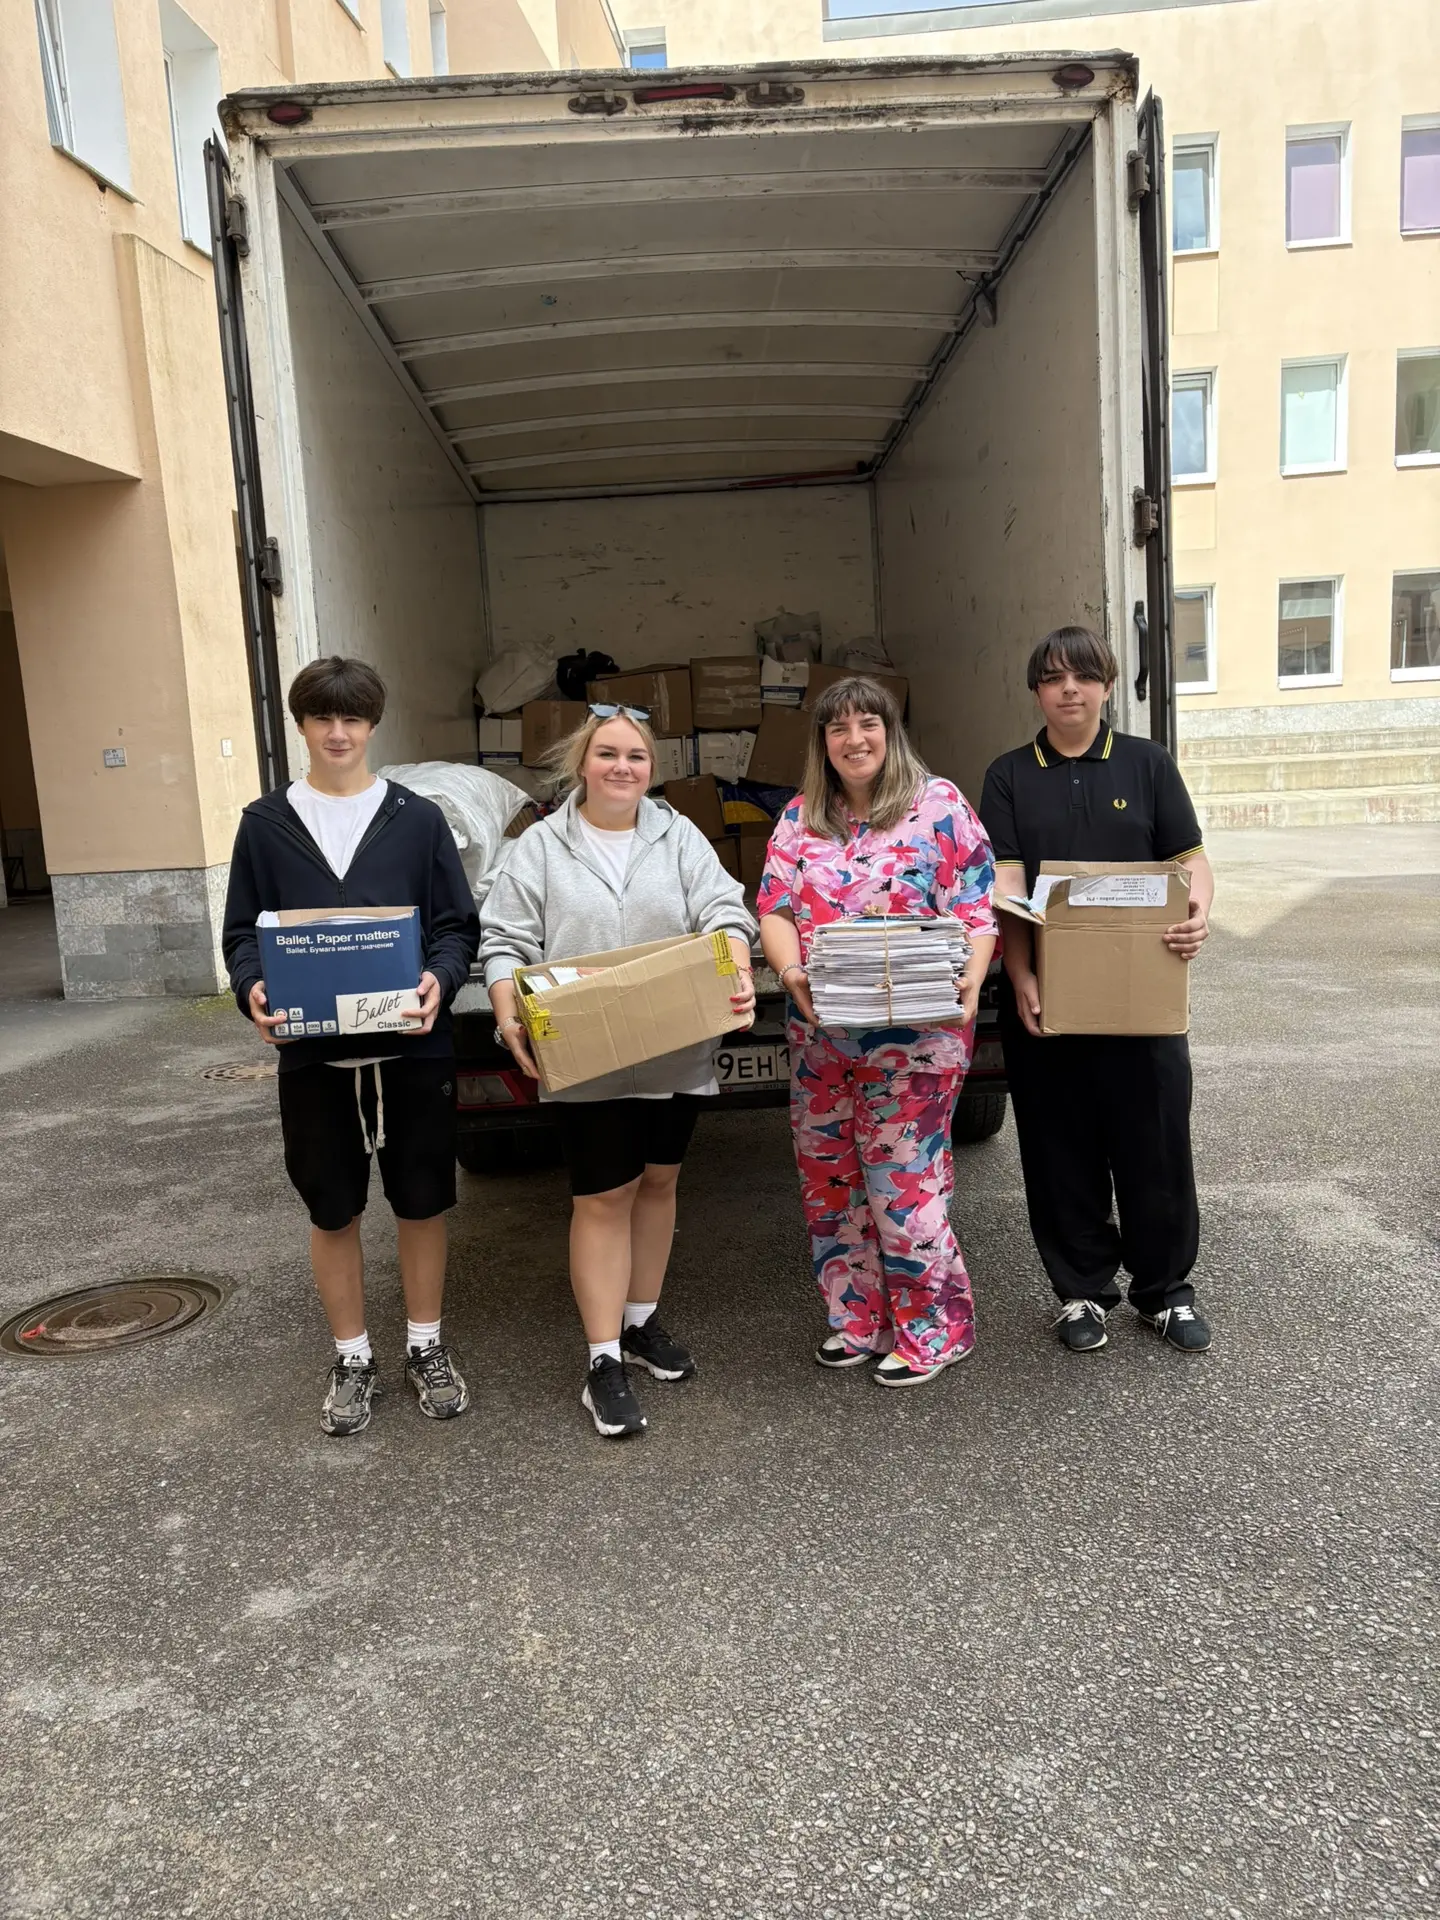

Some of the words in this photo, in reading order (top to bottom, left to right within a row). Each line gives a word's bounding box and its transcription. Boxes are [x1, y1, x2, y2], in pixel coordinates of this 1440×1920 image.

[276, 935, 314, 946] Ballet.
[316, 933, 353, 946] Paper
[355, 930, 400, 942] matters
[309, 946, 336, 955] Бумага
[360, 942, 394, 950] значение
[348, 992, 404, 1029] Ballet
[377, 1020, 411, 1029] Classic
[712, 1052, 773, 1080] 9EH
